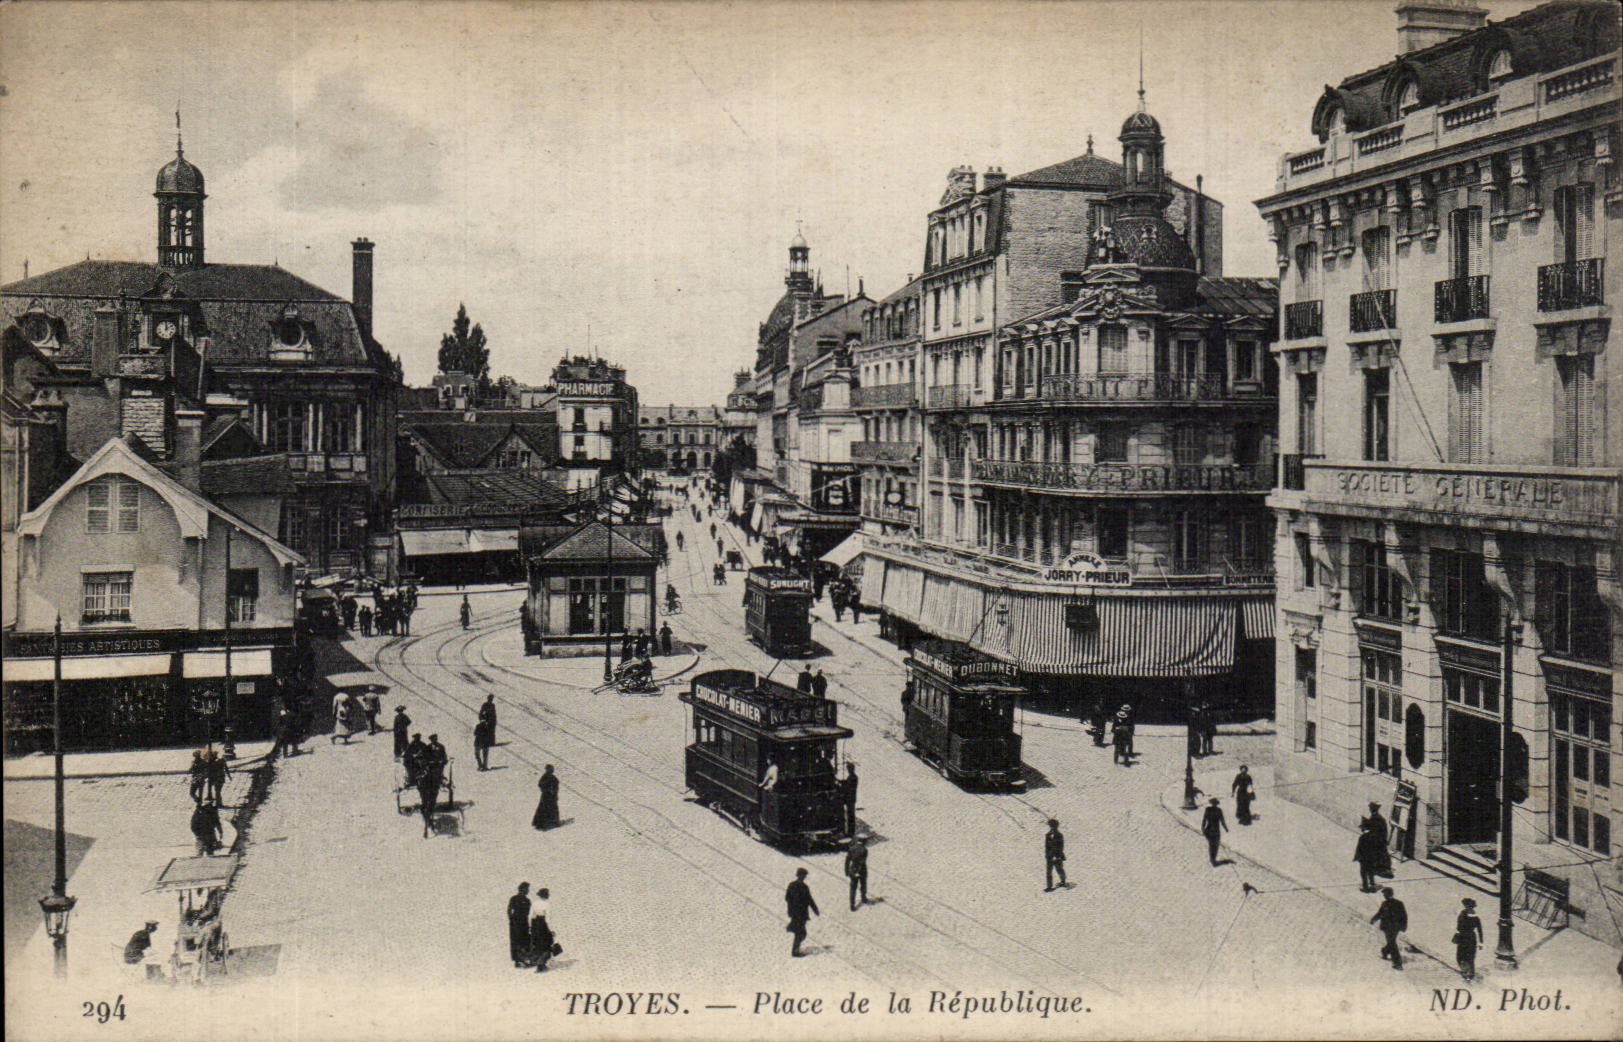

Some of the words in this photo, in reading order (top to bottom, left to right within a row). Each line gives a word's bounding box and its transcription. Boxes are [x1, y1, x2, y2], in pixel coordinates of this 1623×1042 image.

[558, 382, 615, 396] PHARMACIE
[1068, 555, 1102, 569] ANNEXE
[769, 579, 810, 590] SUNLIGHT
[20, 640, 84, 656] FANTASIES
[89, 638, 160, 652] ARTISTIQUES
[961, 662, 1019, 676] DUBONNET
